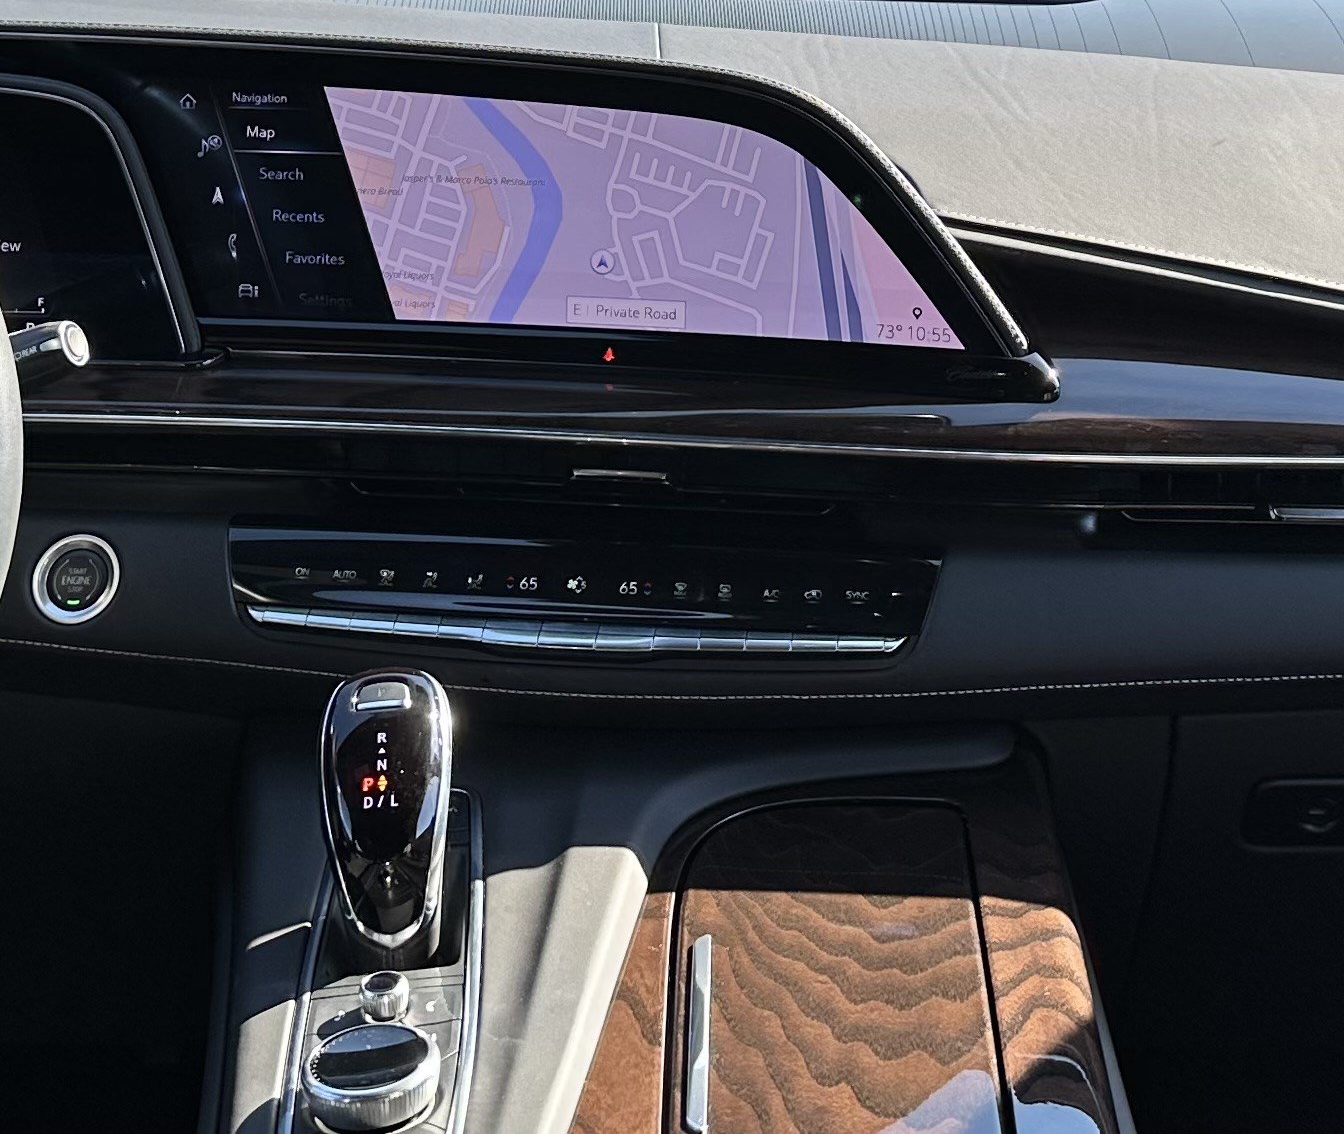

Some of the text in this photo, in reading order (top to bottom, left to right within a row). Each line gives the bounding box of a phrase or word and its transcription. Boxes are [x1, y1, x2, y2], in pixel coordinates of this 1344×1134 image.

[232, 91, 288, 106] Navigation
[246, 125, 275, 141] Map
[258, 167, 304, 181] Search
[400, 173, 433, 184] Jasper's
[444, 175, 472, 185] Marco
[500, 177, 546, 187] Restaurant
[356, 188, 376, 196] nera
[272, 209, 325, 224] Recents
[285, 251, 346, 266] Favorites
[384, 270, 435, 282] oyal Liquors
[37, 297, 45, 307] F
[298, 293, 353, 308] Settings
[404, 300, 436, 309] Liquors
[572, 304, 677, 321] E Private Road
[876, 323, 952, 344] 73° 10:55
[294, 566, 310, 578] ON
[332, 569, 357, 580] AUTO
[61, 575, 92, 586] ENGINE
[519, 577, 538, 591] 65
[619, 581, 638, 595] 65
[763, 589, 781, 599] A/C
[845, 590, 870, 601] SYNC
[377, 732, 387, 744] R
[376, 758, 388, 771] N
[362, 777, 374, 792] P
